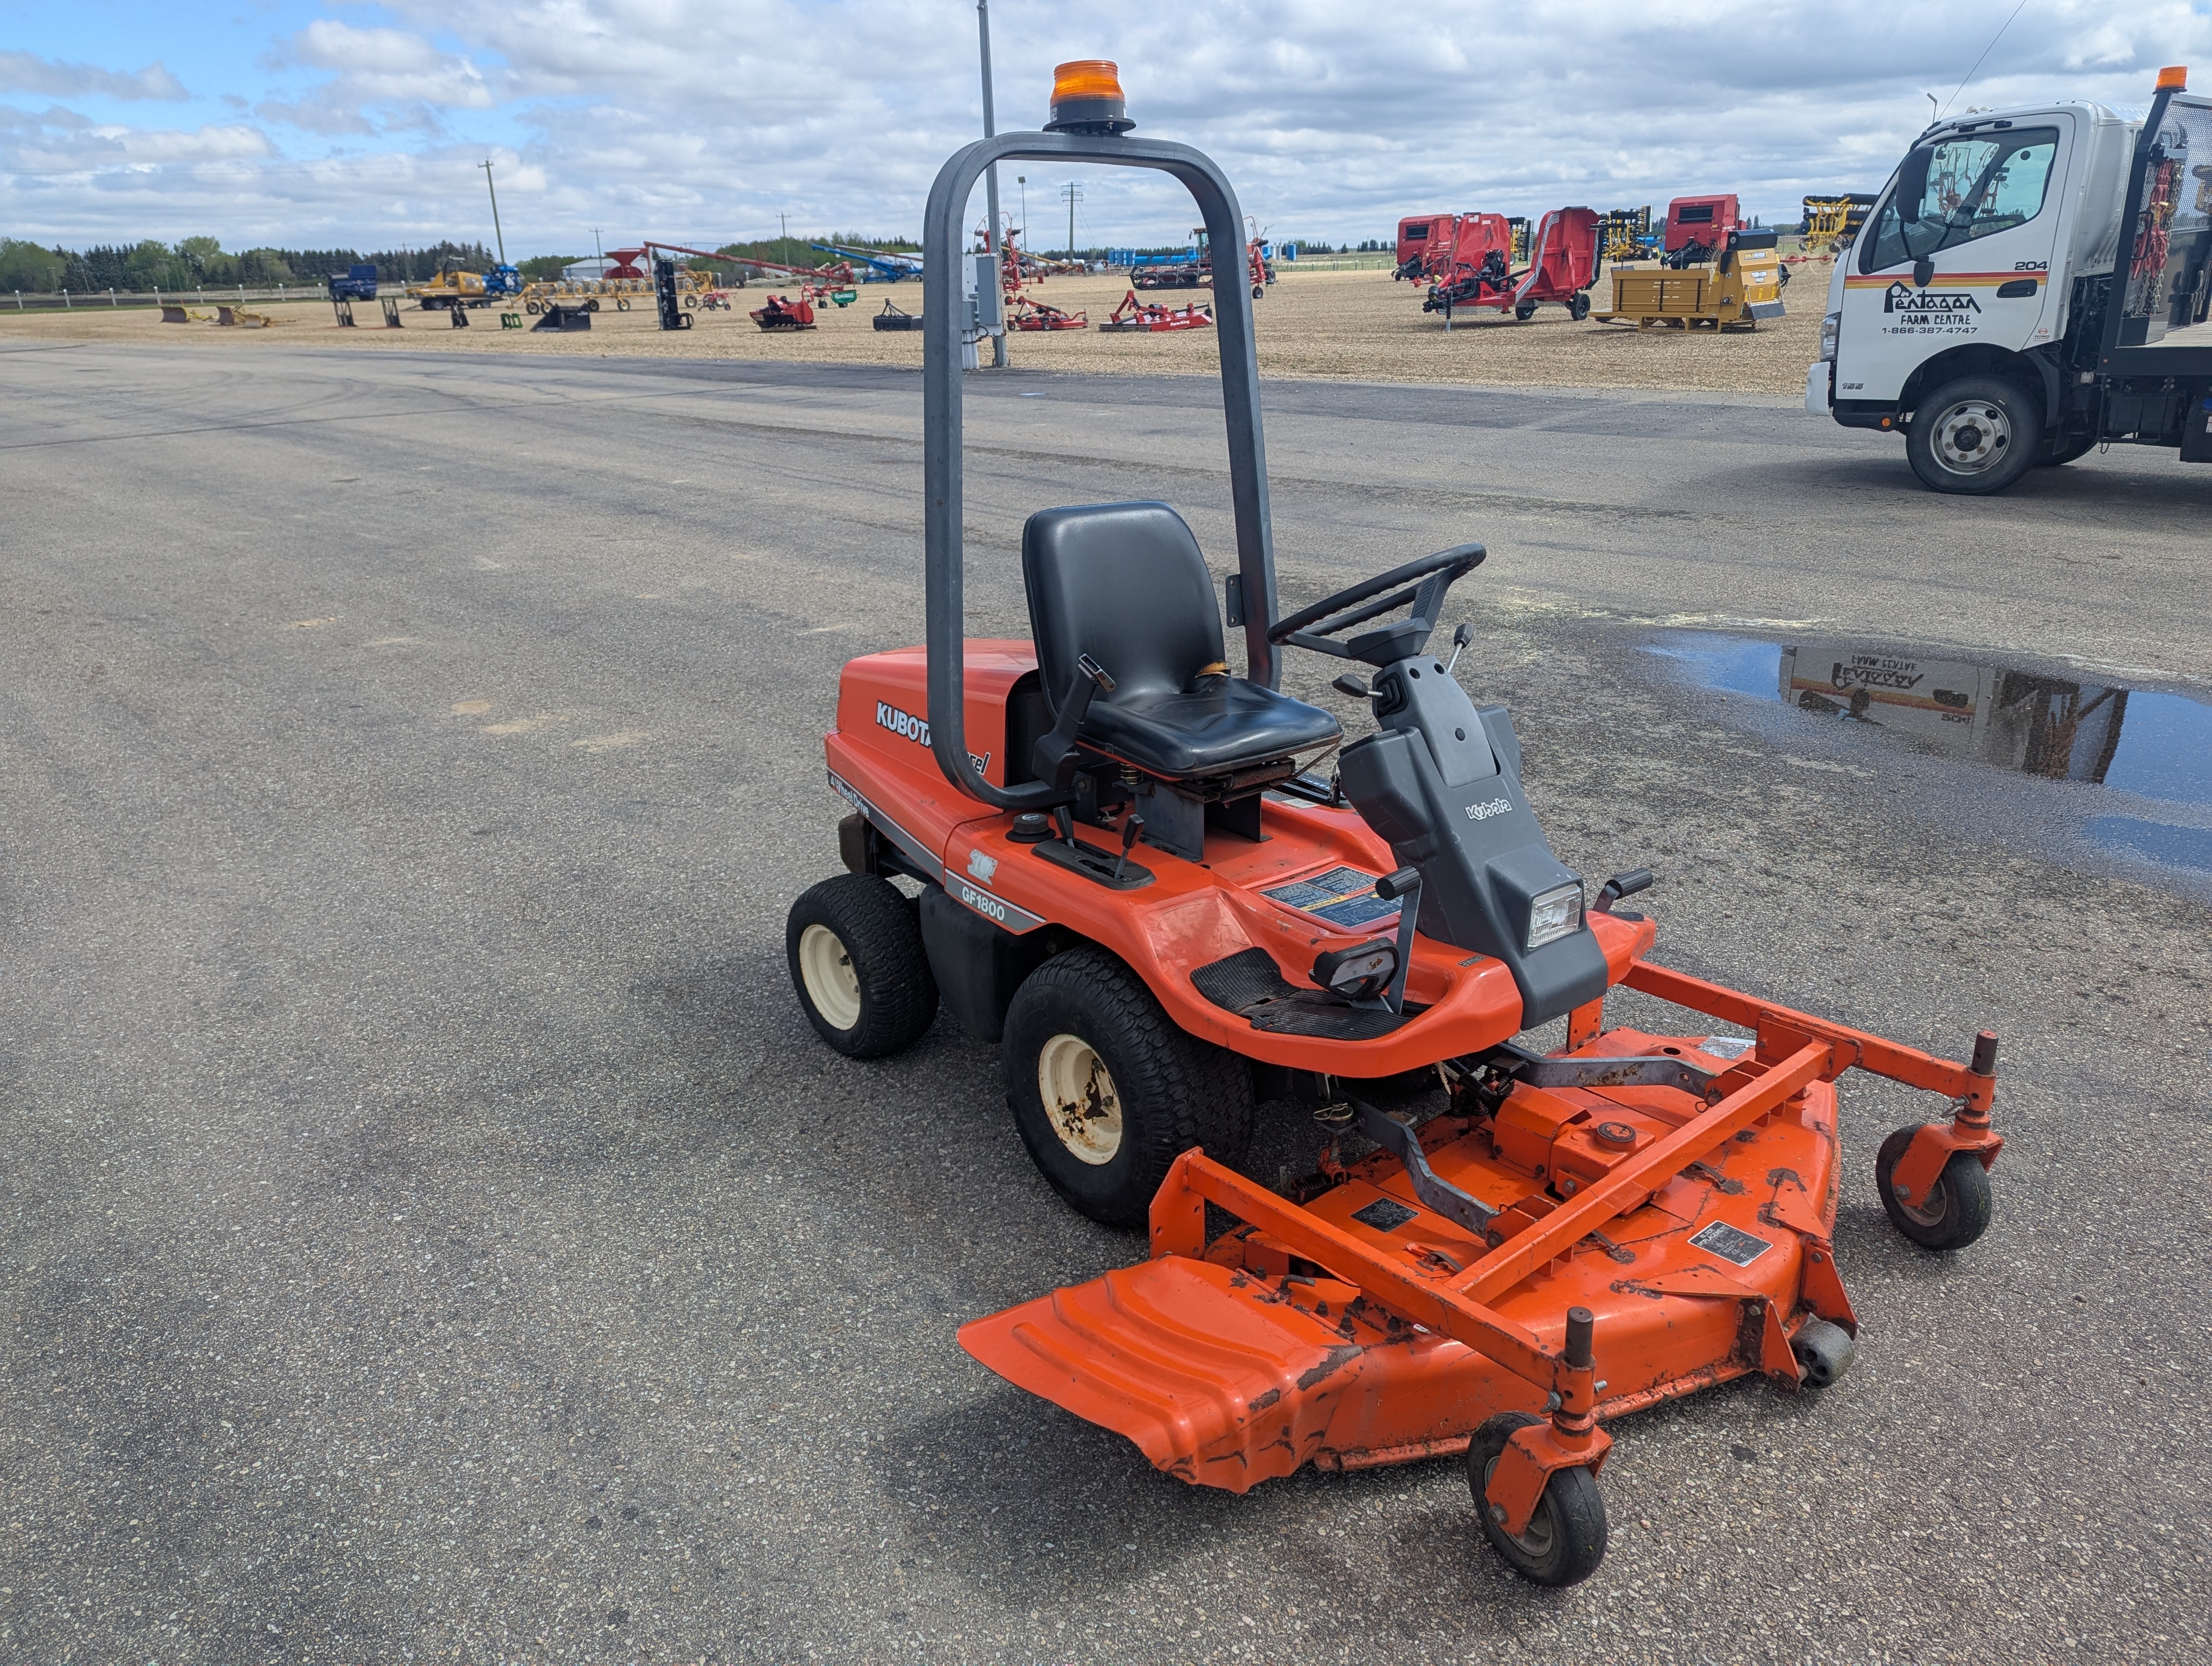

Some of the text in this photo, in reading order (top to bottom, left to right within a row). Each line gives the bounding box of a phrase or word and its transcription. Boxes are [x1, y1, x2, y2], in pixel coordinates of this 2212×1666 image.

[2015, 261, 2048, 271] 204
[1883, 279, 1982, 313] Pentagon
[1901, 315, 1971, 325] FARM CENTRE
[830, 776, 869, 818] 4 Wheel Drive
[1465, 798, 1513, 821] Kubota
[962, 886, 1005, 921] GF1800
[1697, 1225, 1728, 1247] REPLACEMENT
[1699, 1227, 1715, 1239] BLADE
